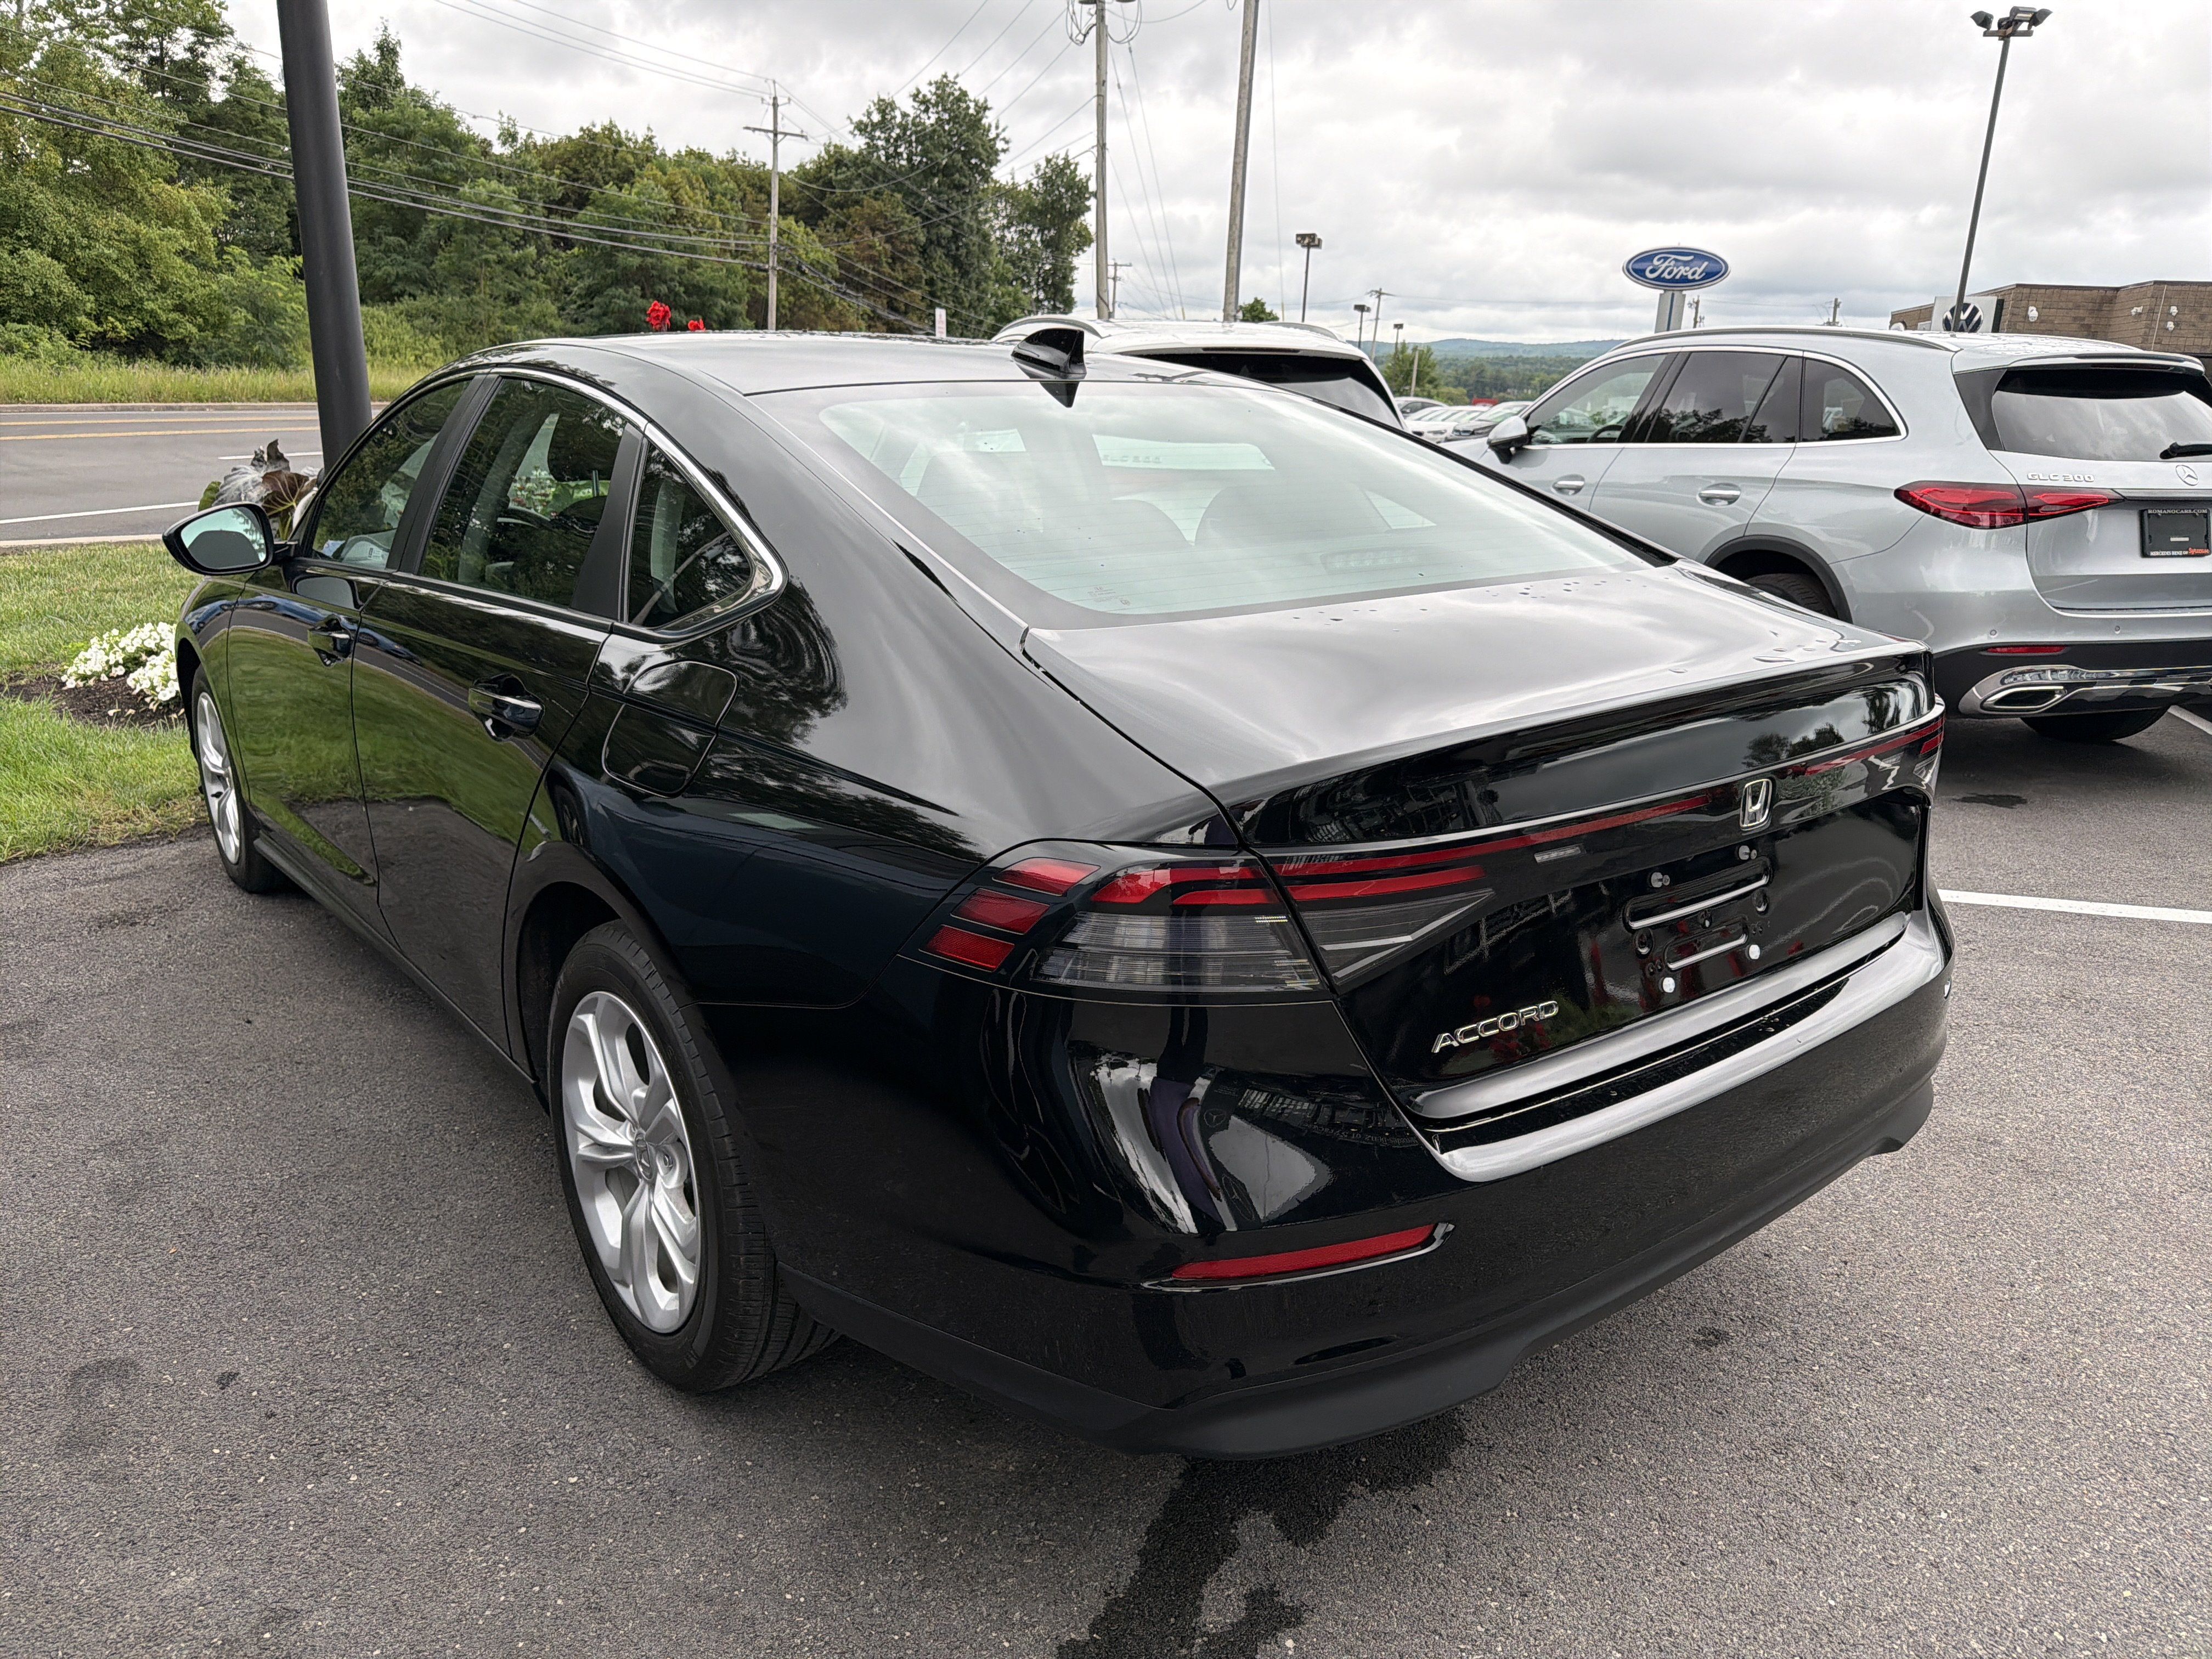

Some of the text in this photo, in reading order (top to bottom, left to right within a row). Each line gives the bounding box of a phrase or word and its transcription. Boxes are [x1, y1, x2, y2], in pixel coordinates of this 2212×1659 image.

[1645, 254, 1708, 280] Ford
[2027, 472, 2095, 482] GLC 300
[1431, 1000, 1559, 1053] ACCORD
